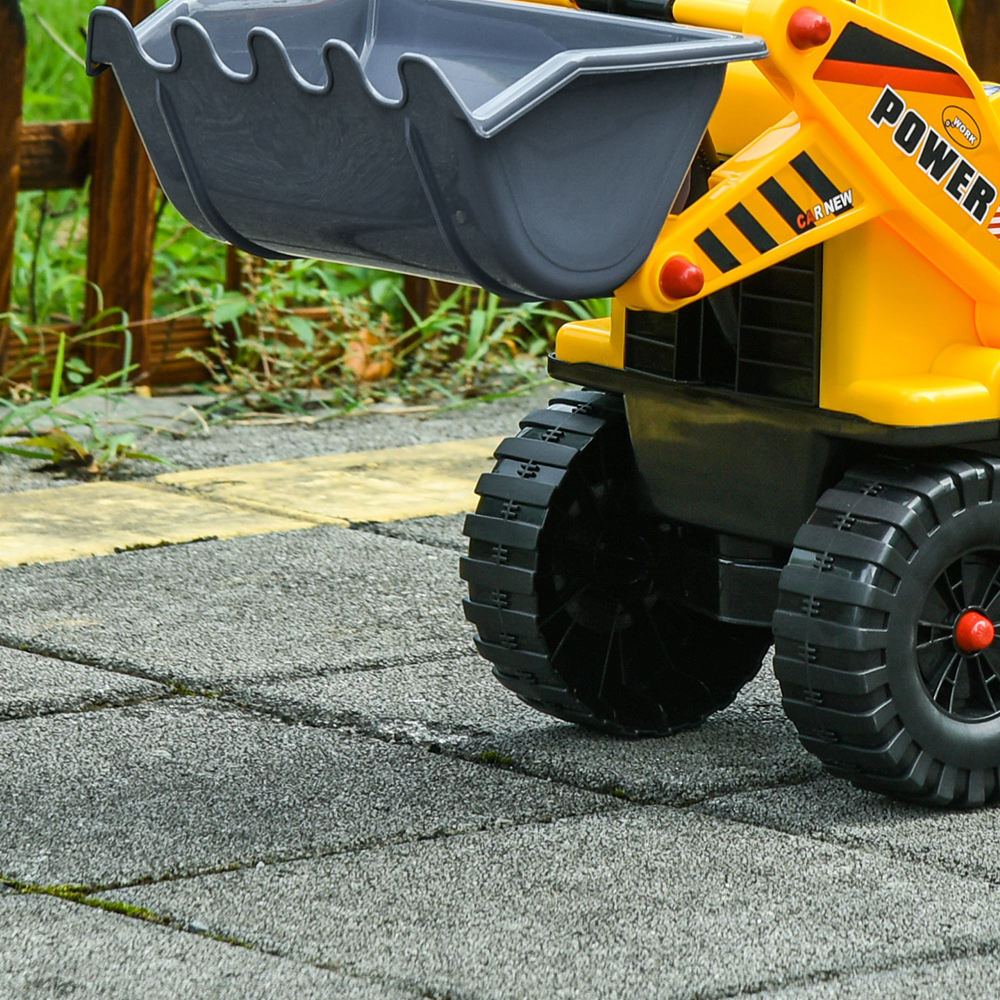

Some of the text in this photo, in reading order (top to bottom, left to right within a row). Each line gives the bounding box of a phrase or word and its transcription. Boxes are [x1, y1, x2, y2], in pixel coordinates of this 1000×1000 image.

[953, 116, 977, 145] WORK
[869, 84, 998, 225] POWER
[796, 189, 853, 230] CAR NEW
